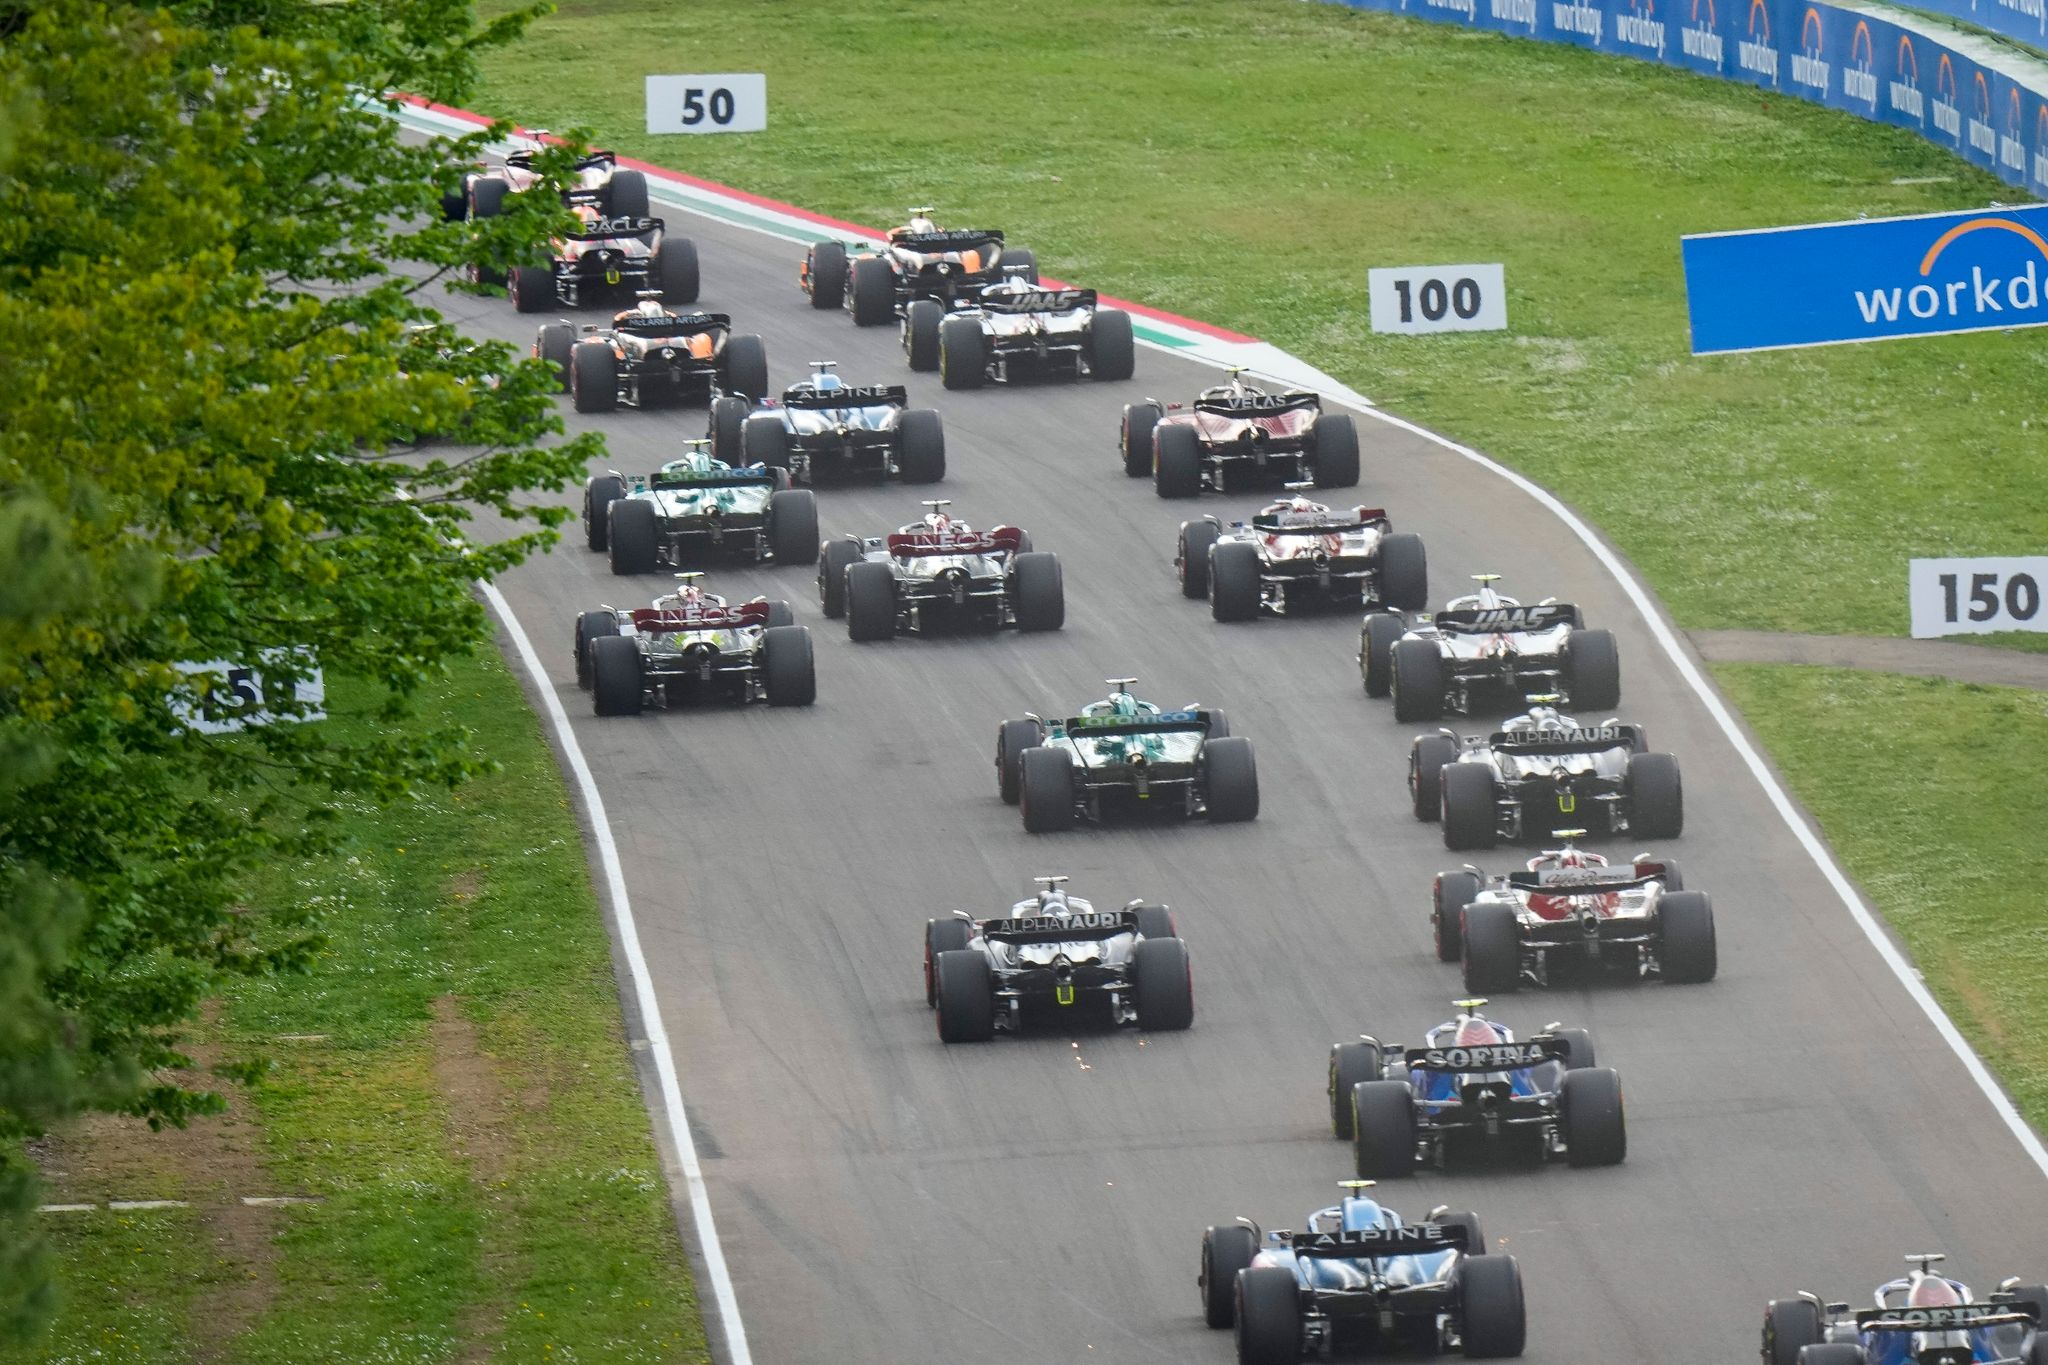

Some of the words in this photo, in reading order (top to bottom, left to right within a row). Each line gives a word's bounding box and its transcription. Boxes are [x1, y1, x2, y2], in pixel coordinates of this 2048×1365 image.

[1616, 7, 1666, 59] workday
[681, 88, 735, 125] 50
[586, 217, 652, 233] RACLE
[1008, 292, 1081, 312] HAAS
[1394, 278, 1481, 323] 100
[1855, 261, 2048, 323] workd
[798, 387, 888, 399] ALPINE
[1228, 395, 1286, 409] VELAS
[914, 531, 995, 551] INEOS
[1939, 572, 2040, 622] 150
[659, 606, 743, 627] INEOS
[1457, 607, 1556, 632] HAAS
[1085, 712, 1191, 727] aramco
[1505, 727, 1620, 745] ALPHATAURI
[1000, 912, 1122, 933] ALPHATAURI
[1425, 1044, 1547, 1069] SOFINA
[1315, 1224, 1443, 1244] ALPINE
[1880, 1304, 2011, 1328] SOFINA
